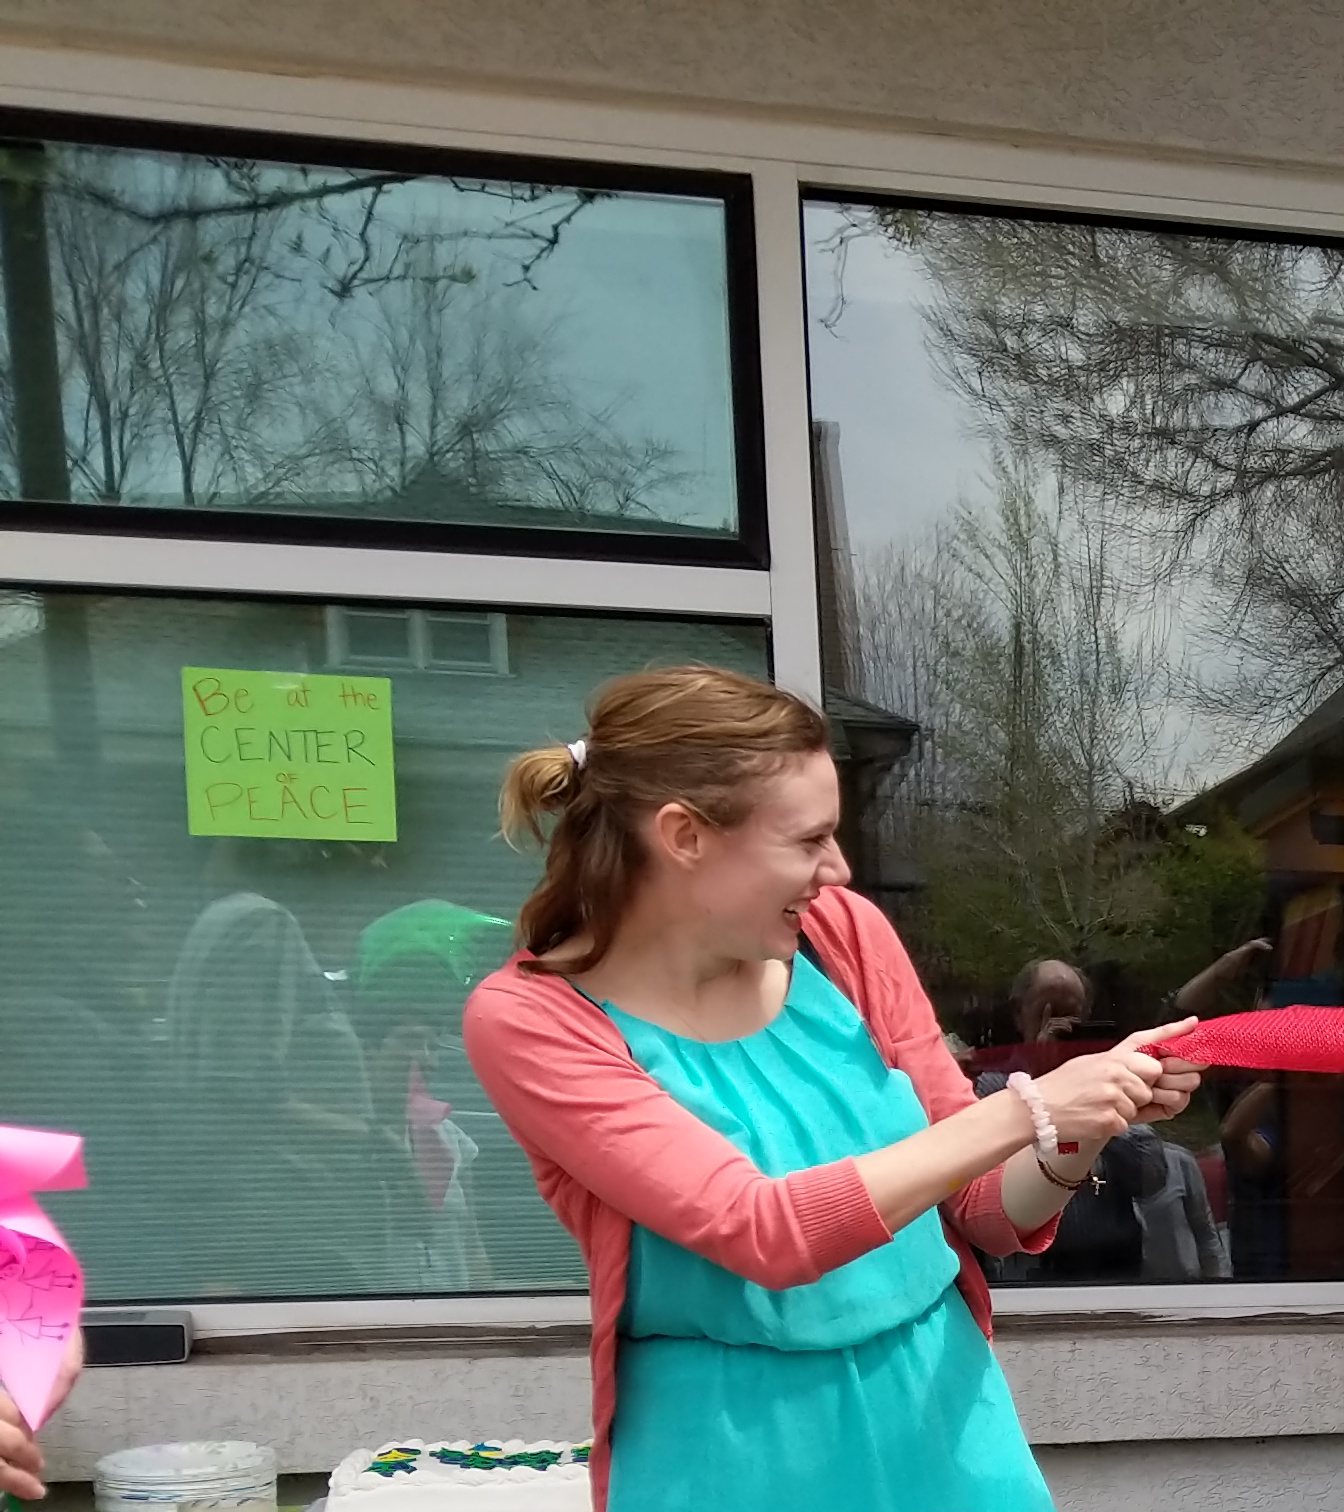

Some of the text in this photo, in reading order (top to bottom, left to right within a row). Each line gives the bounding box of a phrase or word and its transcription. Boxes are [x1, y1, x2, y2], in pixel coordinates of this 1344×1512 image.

[193, 677, 380, 716] Be at the
[200, 725, 376, 766] CENTER
[276, 772, 299, 784] OF
[205, 782, 374, 824] PEACE
